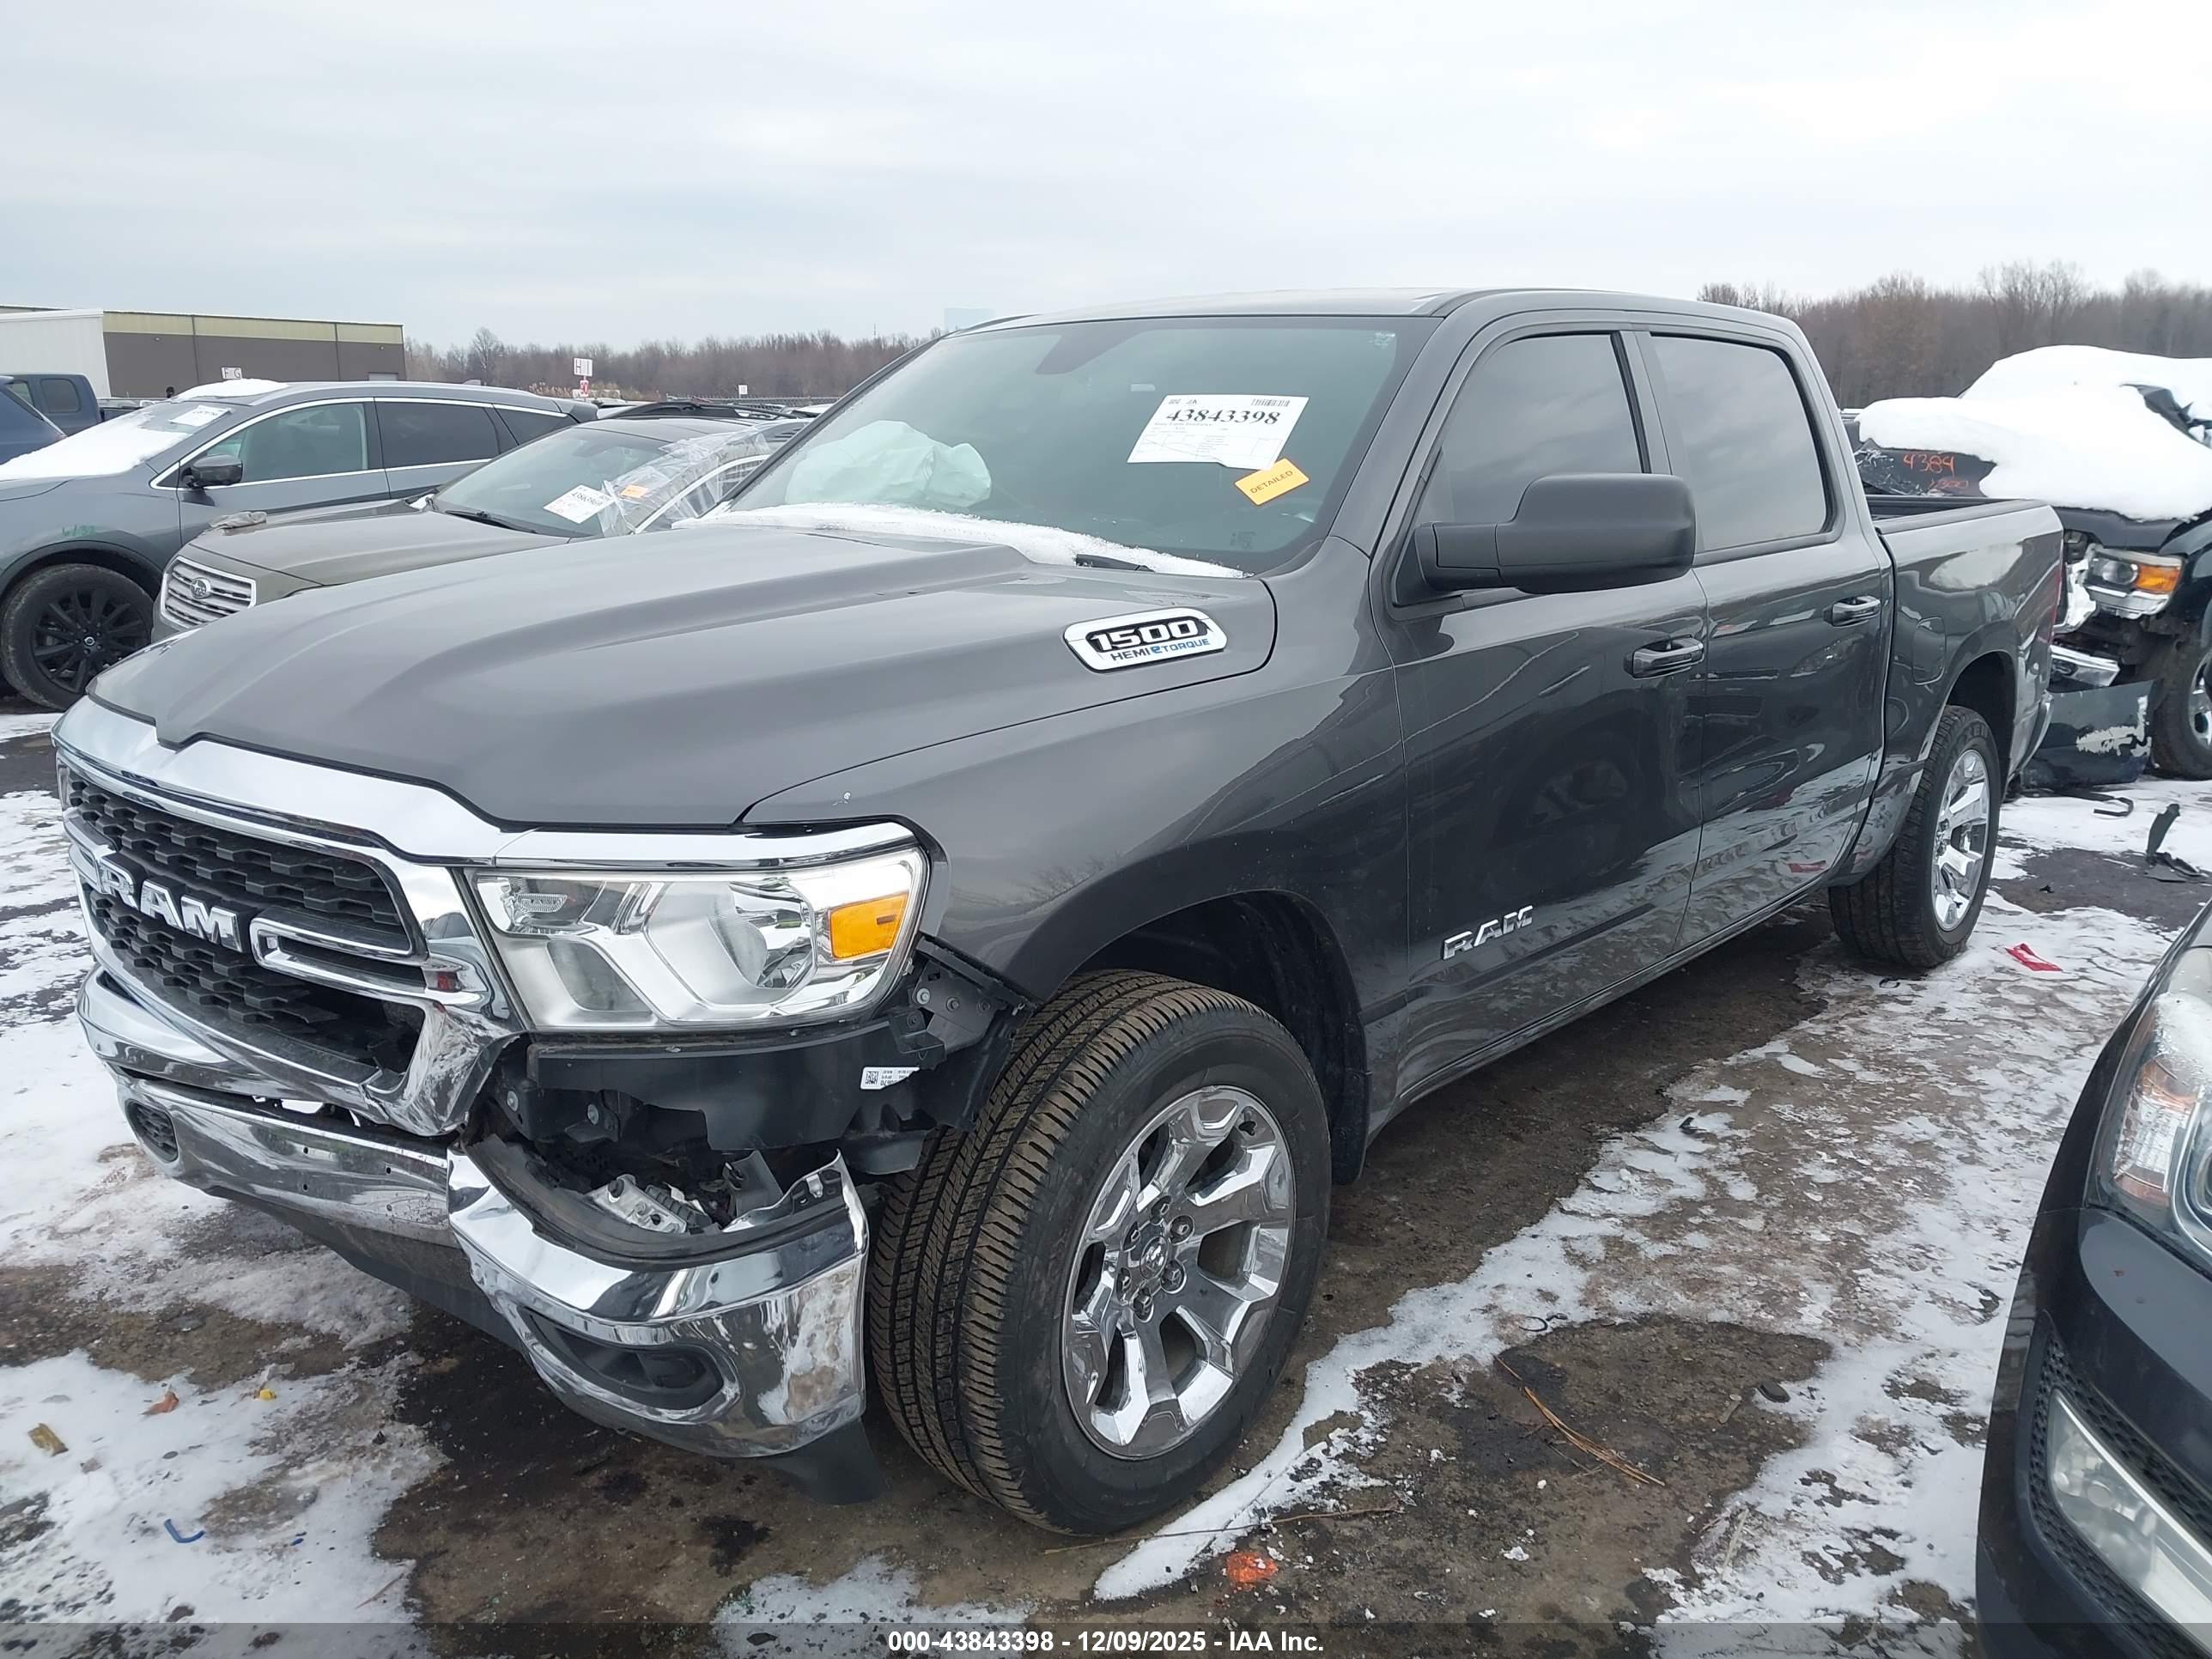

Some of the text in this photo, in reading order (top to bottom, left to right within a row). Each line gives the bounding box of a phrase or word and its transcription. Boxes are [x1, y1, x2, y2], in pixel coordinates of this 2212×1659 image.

[223, 368, 241, 379] F G
[575, 359, 582, 374] H
[1166, 408, 1281, 425] 43843398
[1249, 470, 1293, 494] DETAILED
[1091, 619, 1199, 651] 1500
[1109, 647, 1151, 662] HEMI
[99, 857, 243, 953] RAM
[1443, 905, 1534, 960] RAM
